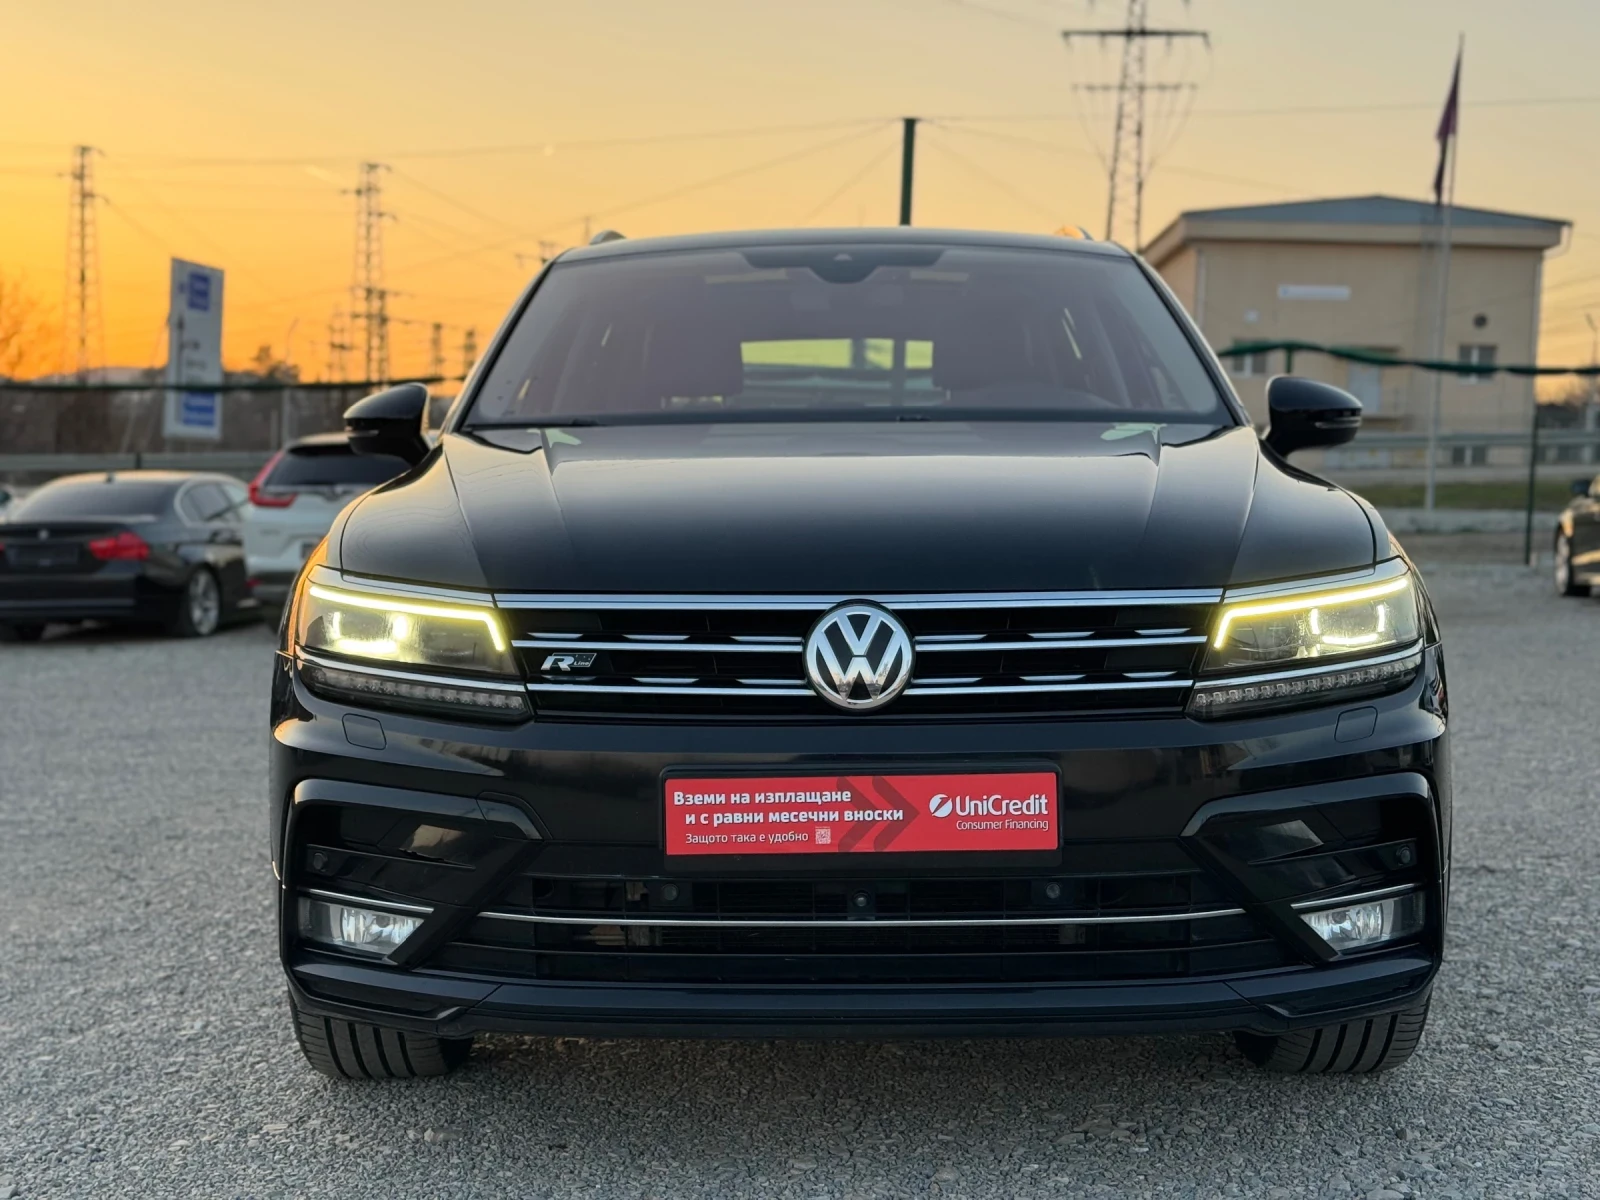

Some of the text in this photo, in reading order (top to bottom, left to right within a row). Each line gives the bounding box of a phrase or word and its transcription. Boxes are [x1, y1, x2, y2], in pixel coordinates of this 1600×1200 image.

[811, 605, 907, 706] VW
[673, 790, 852, 806] Вземи на изплащане
[955, 793, 1048, 816] UniCredit
[685, 809, 904, 827] и с равни месечни вноски
[956, 818, 1049, 831] Consumer Financing
[685, 831, 809, 845] Защото така е удобно
